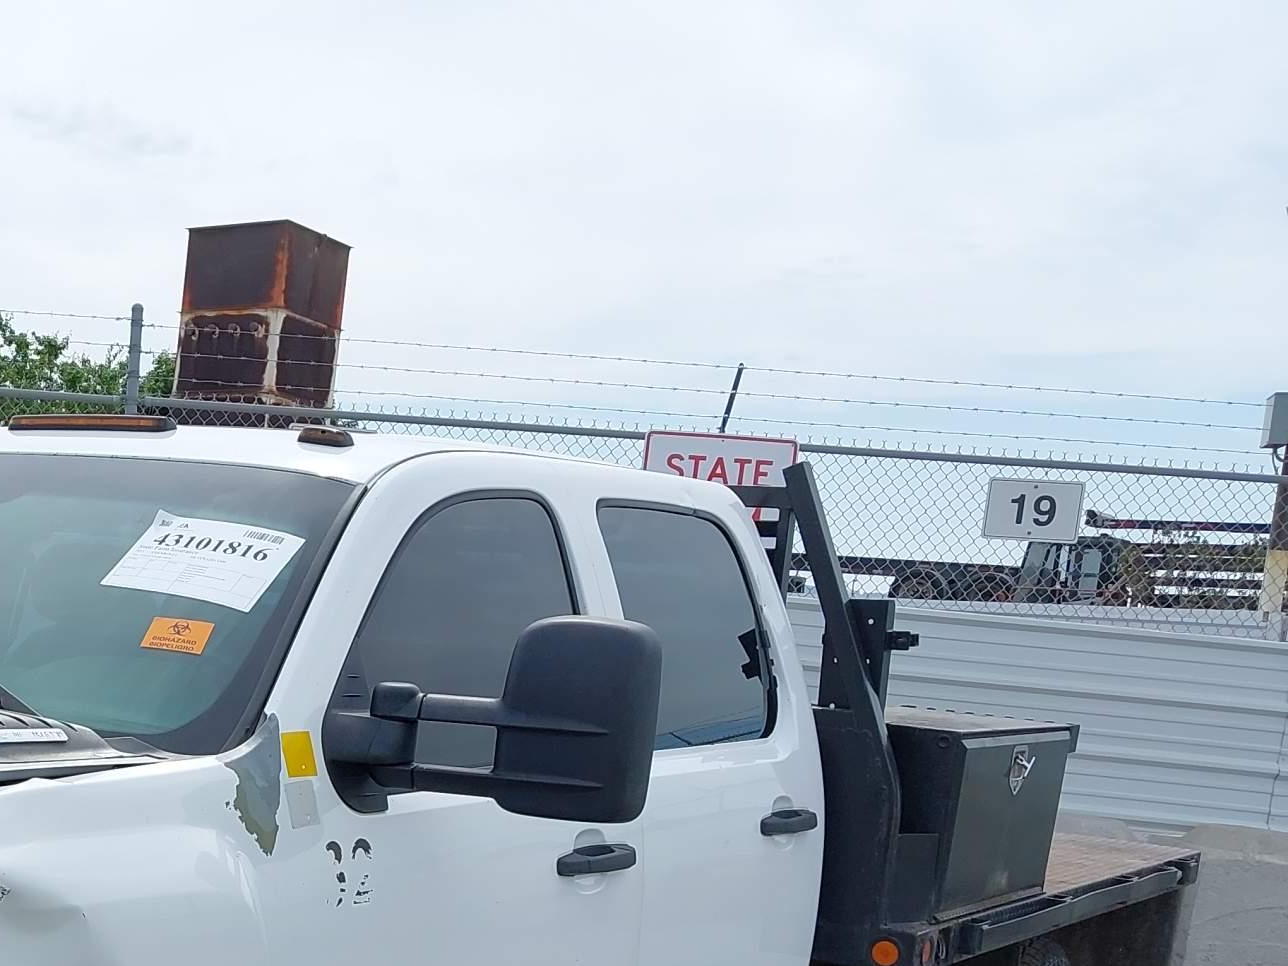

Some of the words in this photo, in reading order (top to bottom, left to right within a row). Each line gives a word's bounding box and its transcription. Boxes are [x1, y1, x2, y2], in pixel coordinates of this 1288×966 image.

[666, 453, 774, 485] STATE
[1010, 493, 1057, 527] 19
[153, 532, 275, 561] 43101816
[149, 641, 194, 651] BIOPELIGRO
[152, 635, 197, 646] BIOHAZARD
